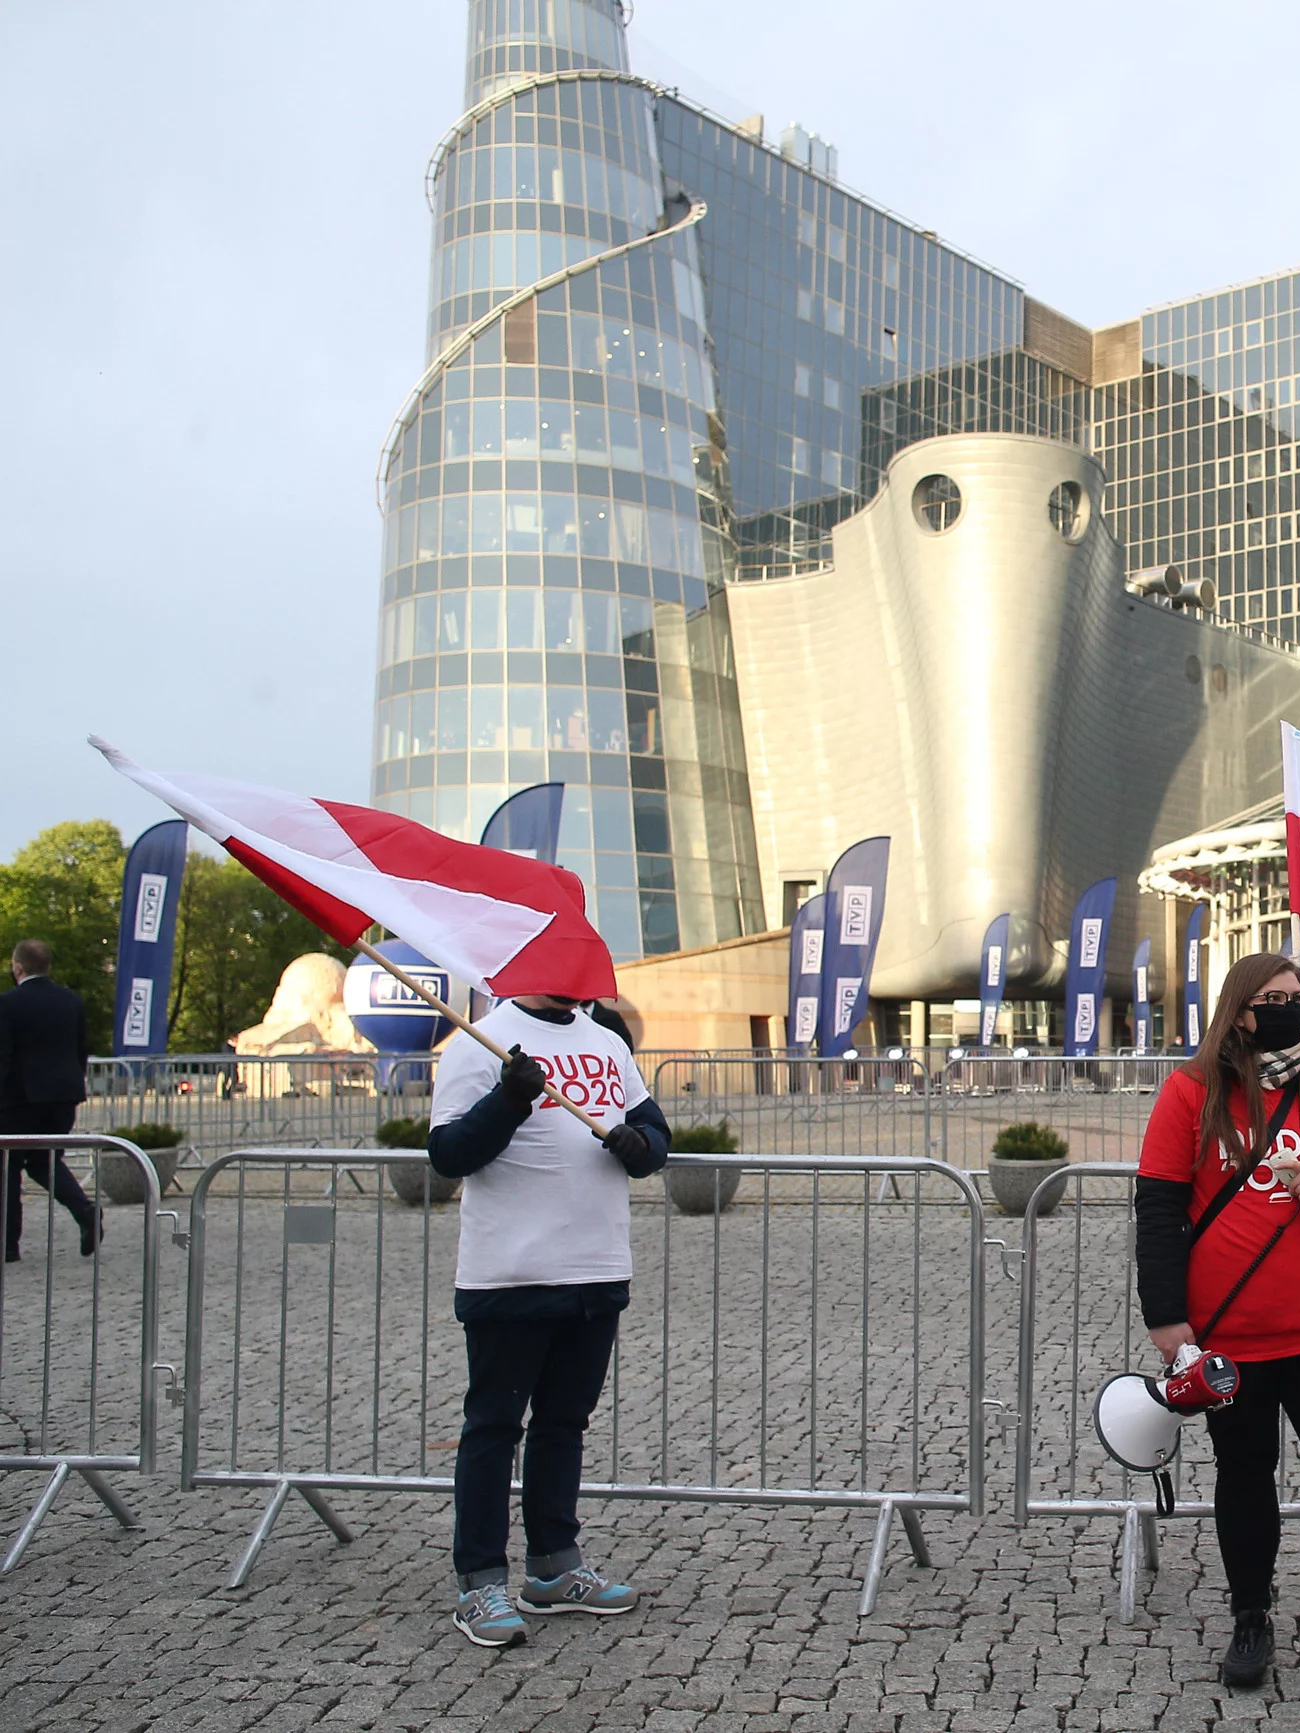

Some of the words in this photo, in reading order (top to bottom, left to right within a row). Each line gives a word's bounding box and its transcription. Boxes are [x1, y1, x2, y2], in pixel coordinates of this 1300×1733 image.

[849, 897, 863, 933] TVP
[808, 938, 817, 964] TVP
[1086, 927, 1096, 957] TVP
[131, 991, 142, 1032] TVP
[801, 1006, 811, 1033] TVP
[1080, 1003, 1090, 1032] TVP
[563, 1581, 593, 1603] N
[464, 1603, 484, 1624] N
